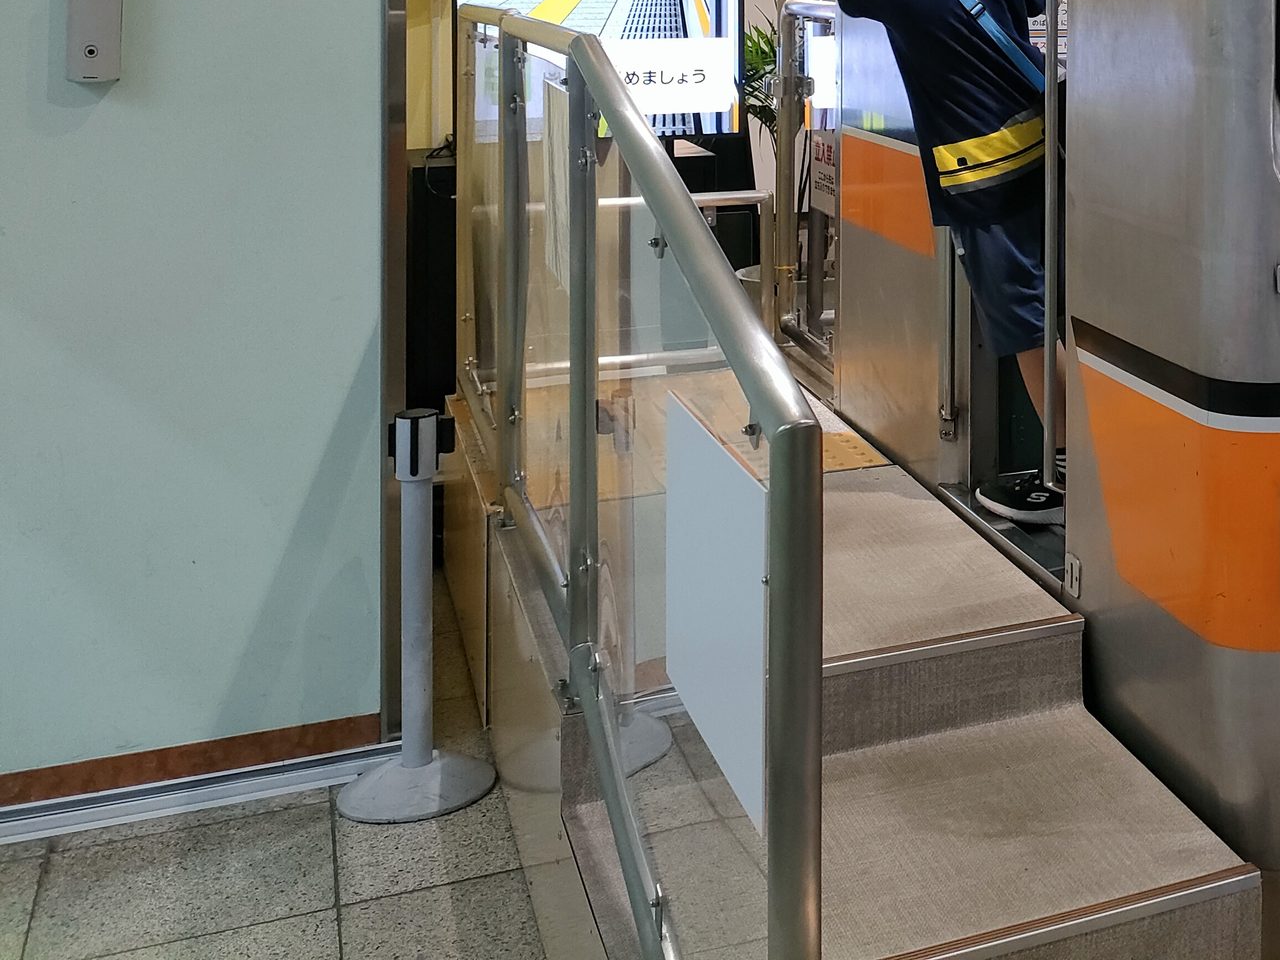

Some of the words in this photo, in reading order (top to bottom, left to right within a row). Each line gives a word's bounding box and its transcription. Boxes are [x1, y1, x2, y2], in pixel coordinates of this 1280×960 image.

[615, 65, 707, 86] めましょう
